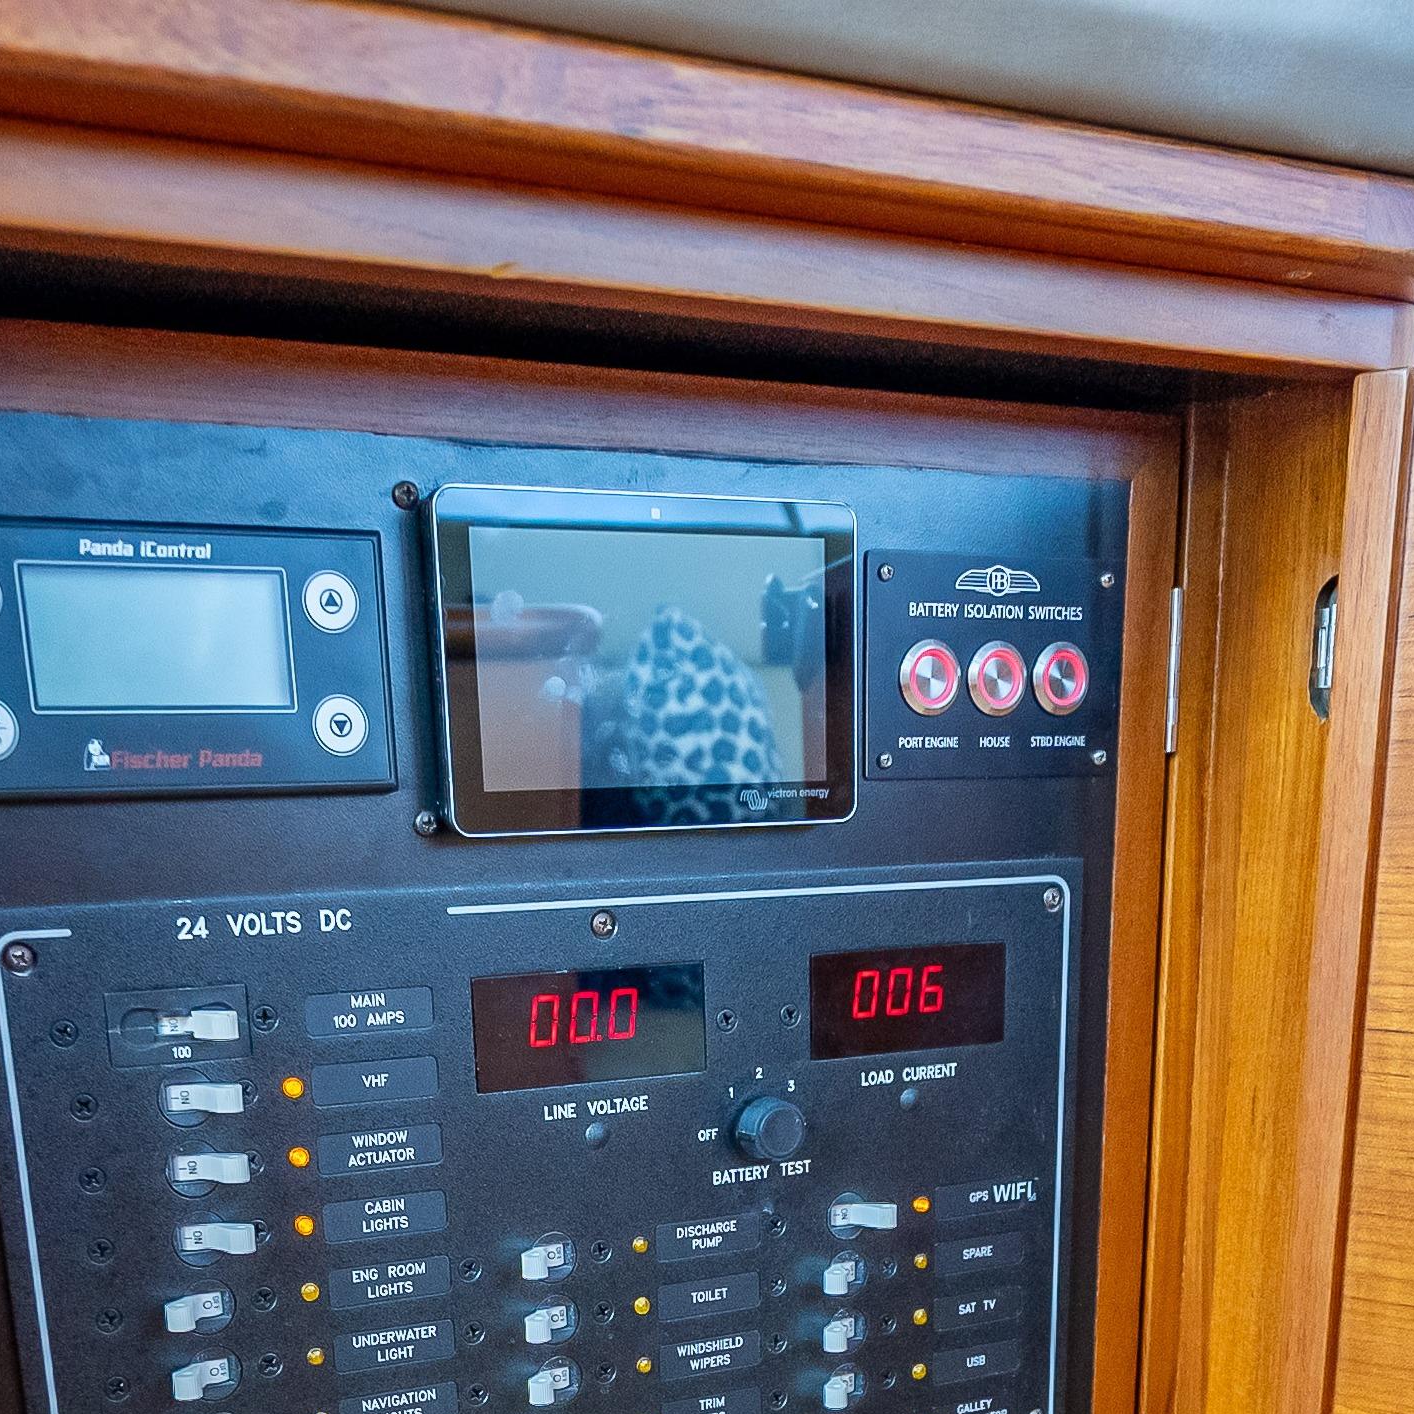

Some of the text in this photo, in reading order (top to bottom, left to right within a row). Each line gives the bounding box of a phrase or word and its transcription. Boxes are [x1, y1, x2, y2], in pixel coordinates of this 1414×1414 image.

[79, 539, 212, 560] Panda iControl
[909, 602, 1083, 621] BATTERY ISOLATION SWITCHES
[899, 737, 959, 748] PORT ENGINE
[979, 737, 1010, 748] HOUSE
[1031, 736, 1086, 747] STBD ENGINE
[111, 749, 262, 769] Fischer Panda
[767, 788, 830, 799] victron energy
[176, 909, 352, 940] 24 VOLTS DC
[852, 964, 944, 1020] 006
[350, 993, 386, 1009] MAIN
[332, 1010, 405, 1029] 100 AMPS
[171, 1046, 192, 1059] 100
[361, 1074, 389, 1089] VHF
[755, 1067, 763, 1080] 2
[860, 1063, 957, 1087] LOAD CURRENT
[728, 1086, 734, 1100] 1
[787, 1080, 795, 1093] 3
[543, 1096, 649, 1121] LINE VOLTAGE
[351, 1130, 409, 1147] WINDOW
[697, 1128, 719, 1143] OFF
[348, 1148, 415, 1168] ACTUATOR
[712, 1160, 812, 1186] BATTERY TEST
[969, 1181, 1034, 1203] GPS WIFI
[364, 1199, 405, 1214] CABIN
[362, 1216, 409, 1233] LIGHTS
[676, 1220, 737, 1239] DISCHARGE
[692, 1236, 723, 1250] PUMP
[962, 1245, 994, 1260] SPARE
[352, 1262, 426, 1283] ENG ROOM
[367, 1281, 413, 1299] LIGHTS
[691, 1288, 728, 1304] TOILET
[958, 1299, 996, 1315] SAT TV
[352, 1326, 437, 1348] UNDERWATER
[377, 1345, 414, 1362] LIGHT
[676, 1337, 744, 1357] WINDSHIELD
[690, 1354, 731, 1371] WIPERS
[966, 1355, 986, 1367] USB
[361, 1389, 436, 1411] NAVIGATION
[699, 1396, 725, 1411] TRIM
[957, 1398, 993, 1414] GALLEY
